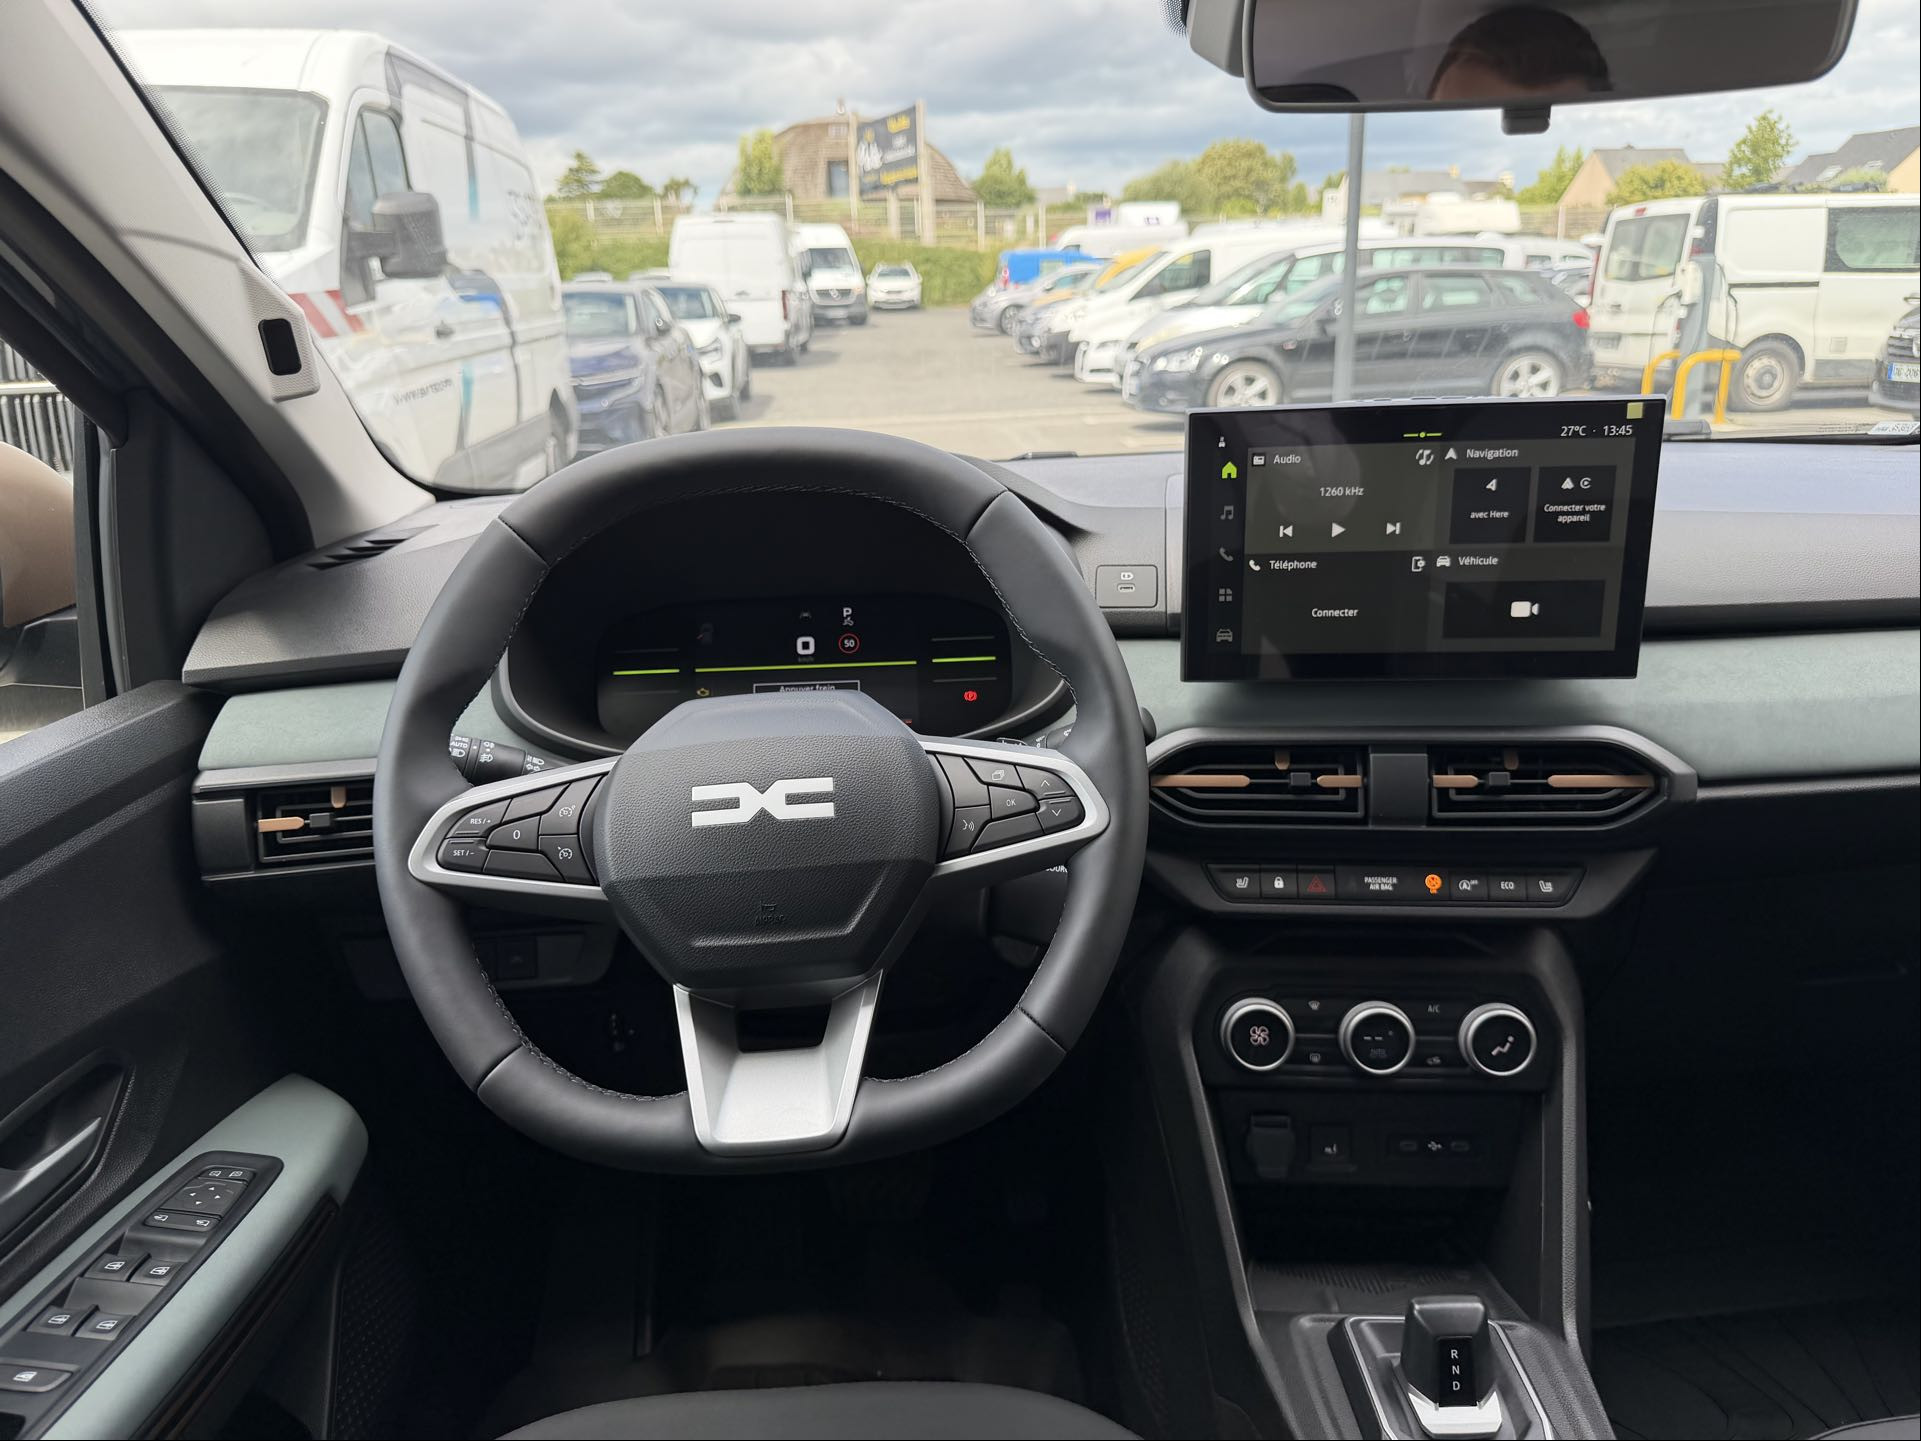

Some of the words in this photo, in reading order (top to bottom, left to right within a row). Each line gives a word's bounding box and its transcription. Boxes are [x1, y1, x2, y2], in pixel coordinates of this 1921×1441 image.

[1602, 424, 1633, 436] 13:45
[1466, 448, 1519, 460] Navigation
[1273, 454, 1302, 464] Audio
[1319, 486, 1344, 496] 1260
[1345, 486, 1365, 496] kHz
[1543, 503, 1584, 512] Connecter
[1585, 503, 1606, 511] votre
[1470, 511, 1489, 519] avec
[1490, 510, 1509, 518] Here
[1557, 513, 1590, 524] appareil
[1458, 555, 1499, 566] Véhicule
[1269, 559, 1318, 572] Téléphone
[843, 607, 853, 618] P
[1311, 608, 1359, 617] Connecter
[843, 639, 856, 648] 50
[451, 741, 468, 749] AUTO
[1006, 798, 1017, 807] OK
[1364, 876, 1397, 884] PASSENGER
[1381, 883, 1393, 891] BAG
[1500, 881, 1514, 890] ECO
[1427, 1004, 1440, 1013] A/C
[1450, 1349, 1459, 1359] R
[1452, 1365, 1460, 1375] N
[1452, 1381, 1460, 1390] D
